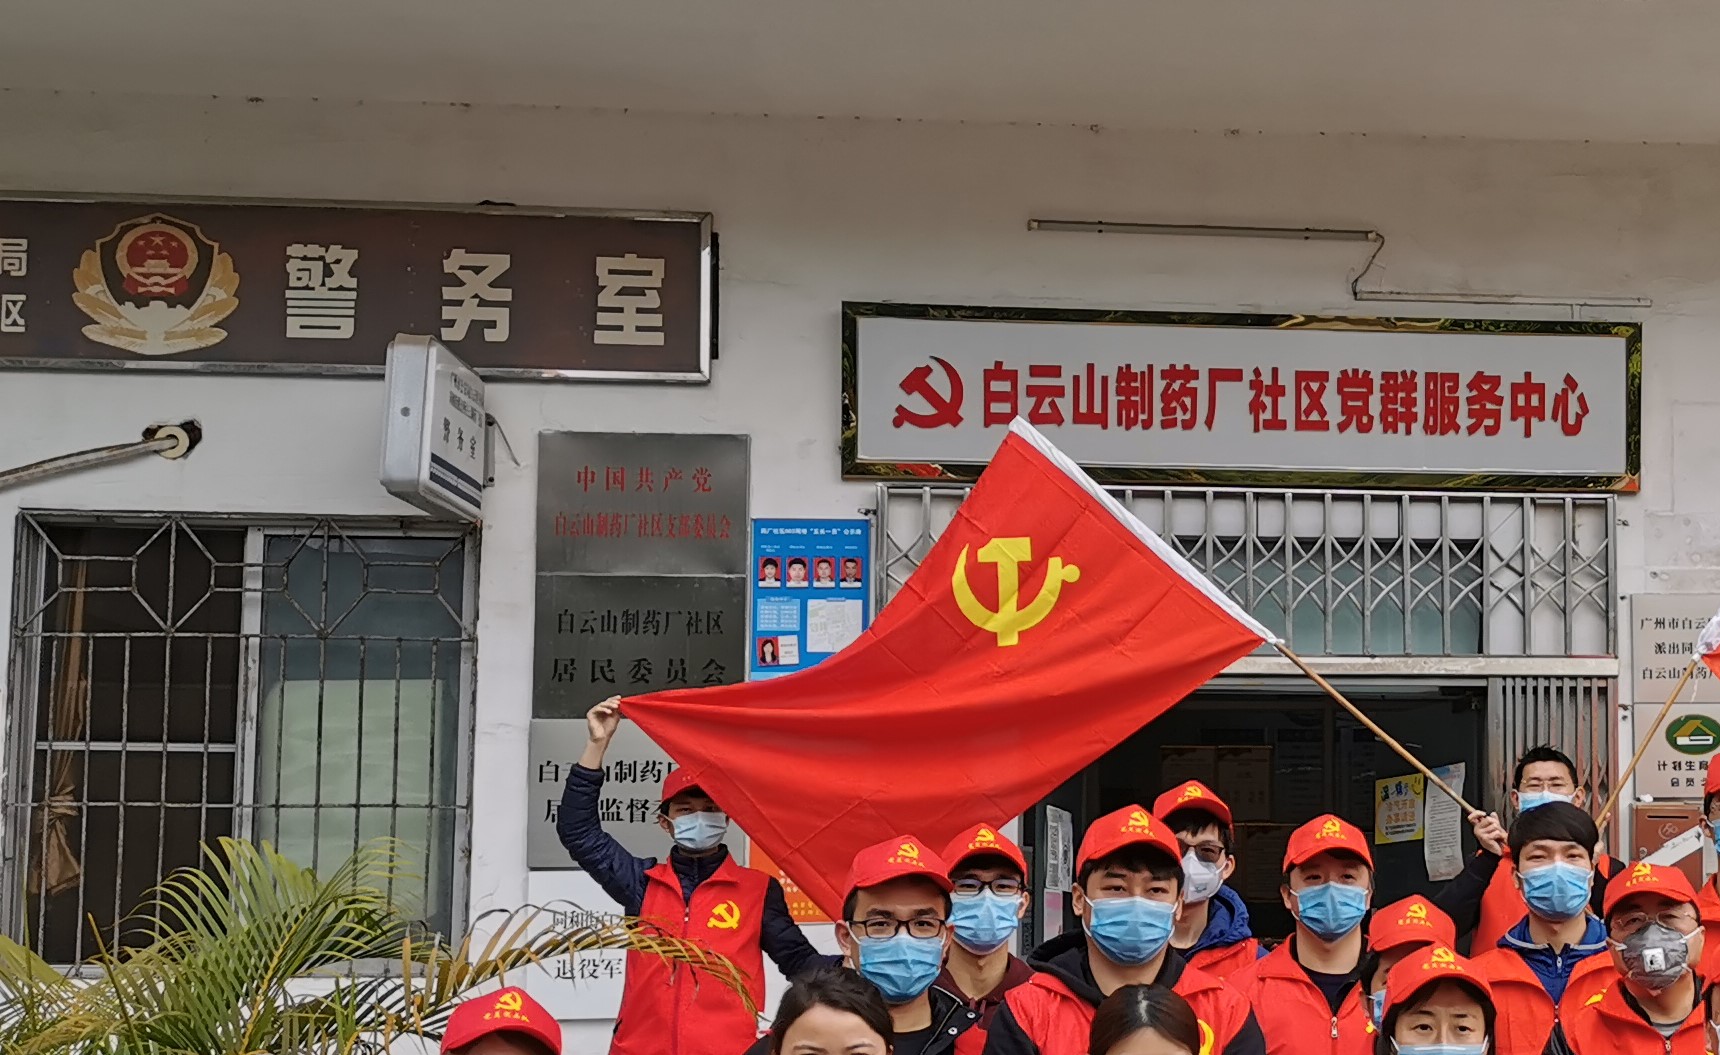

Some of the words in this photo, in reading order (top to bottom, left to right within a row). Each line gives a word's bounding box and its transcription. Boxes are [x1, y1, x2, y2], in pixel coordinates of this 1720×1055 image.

[0, 238, 28, 276] 局
[285, 244, 666, 346] 警务室
[1, 294, 27, 332] 区
[981, 359, 1590, 438] 白云山制药厂社区党群服务中心
[576, 465, 712, 493] 中国共产党
[554, 511, 732, 539] 白云山制药厂社区支部委员会
[557, 608, 724, 636] 白云山制药厂社区
[1640, 617, 1712, 630] 广州市白云
[551, 656, 726, 684] 居民委员会
